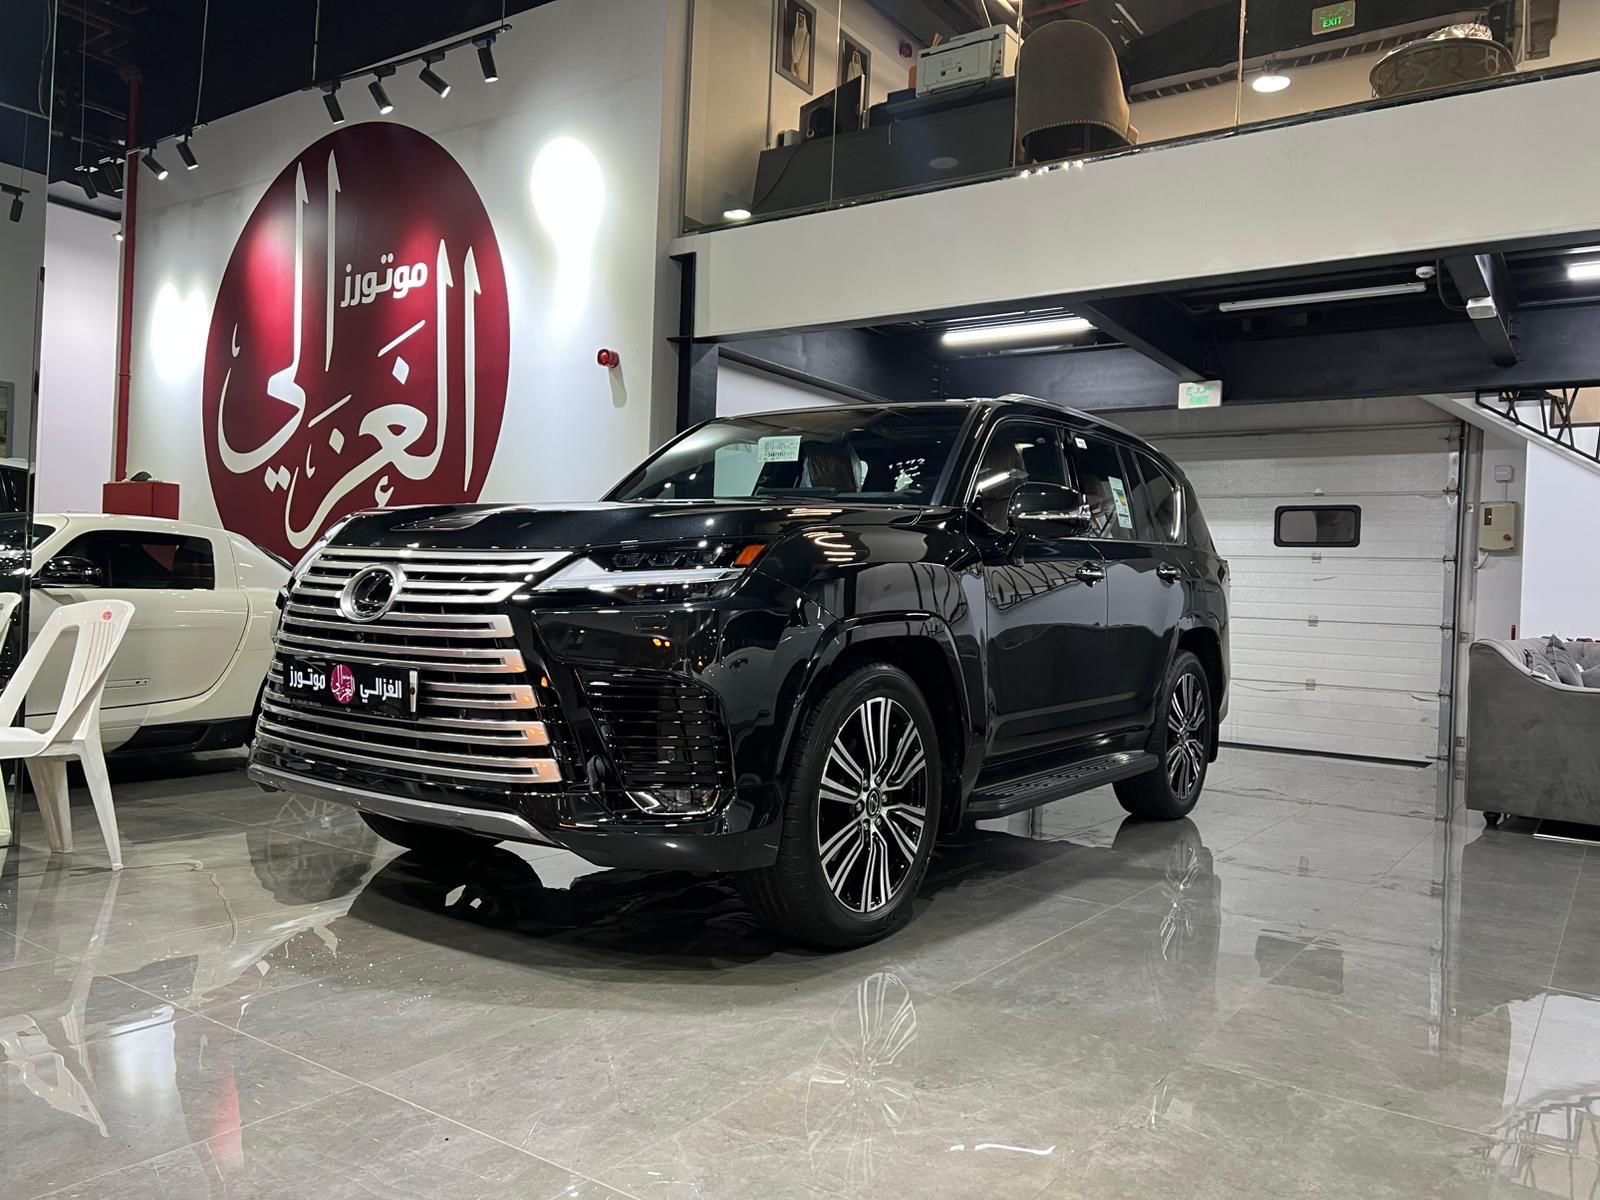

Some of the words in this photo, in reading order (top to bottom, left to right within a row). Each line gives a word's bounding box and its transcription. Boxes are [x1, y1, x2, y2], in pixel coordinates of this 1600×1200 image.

[1322, 16, 1343, 28] EXIT
[340, 253, 428, 307] موتورز
[289, 665, 326, 691] موتورز
[359, 677, 402, 703] الغزالي
